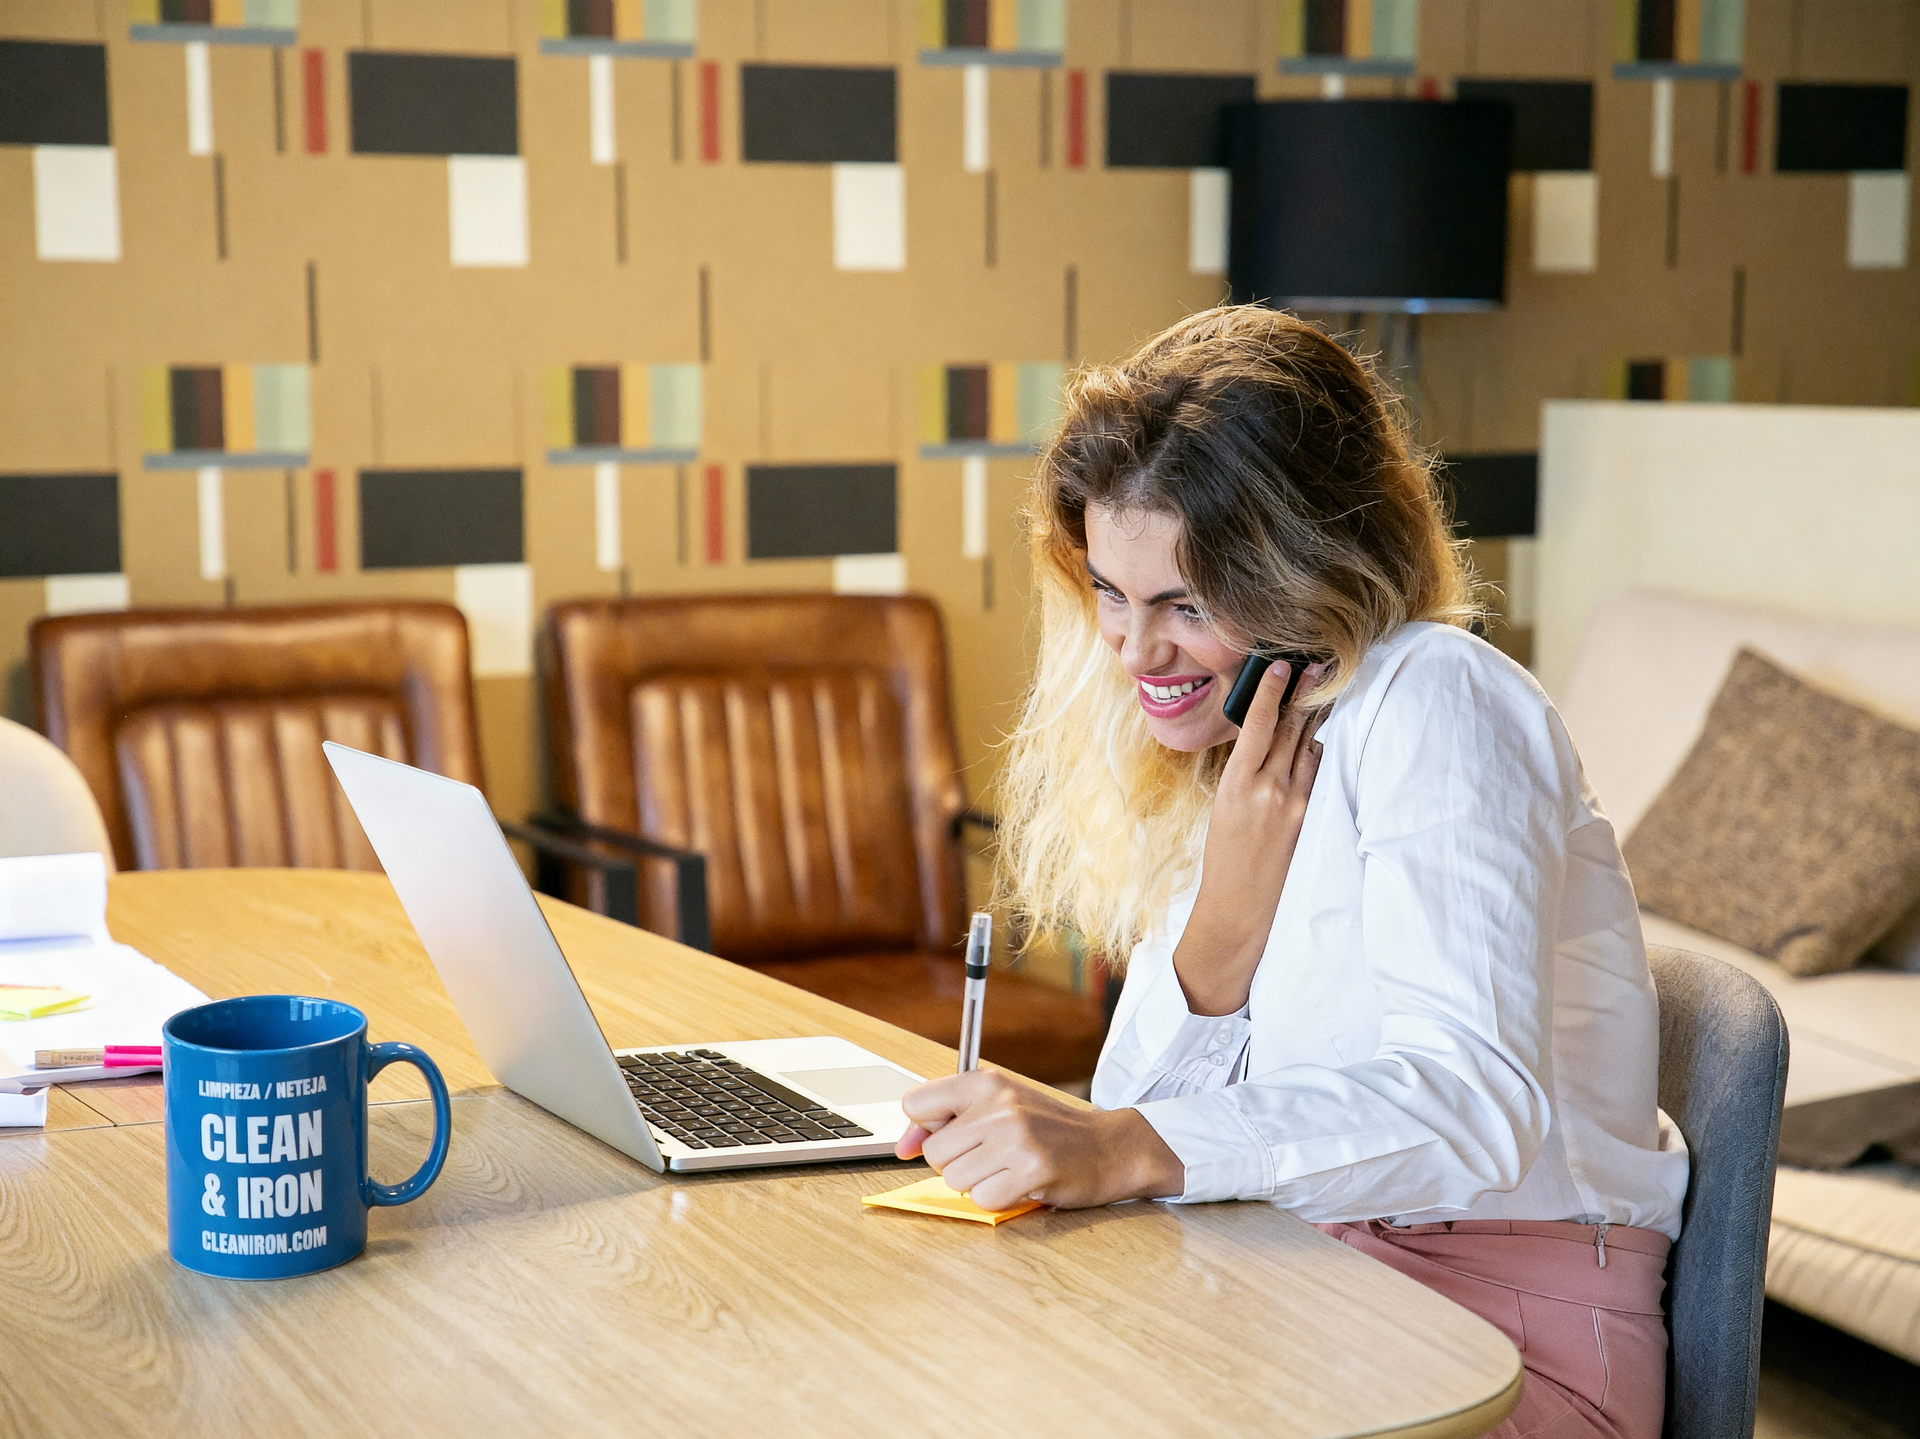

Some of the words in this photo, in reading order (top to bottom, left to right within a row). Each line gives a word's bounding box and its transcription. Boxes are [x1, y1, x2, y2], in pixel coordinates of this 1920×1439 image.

[199, 1080, 260, 1100] LIMPIEZA
[264, 1083, 273, 1100] /
[276, 1075, 327, 1099] NETEJA
[201, 1109, 323, 1164] CLEAN
[201, 1172, 227, 1217] &
[237, 1168, 323, 1219] IRON
[201, 1225, 327, 1256] CLEANIRON.COM
